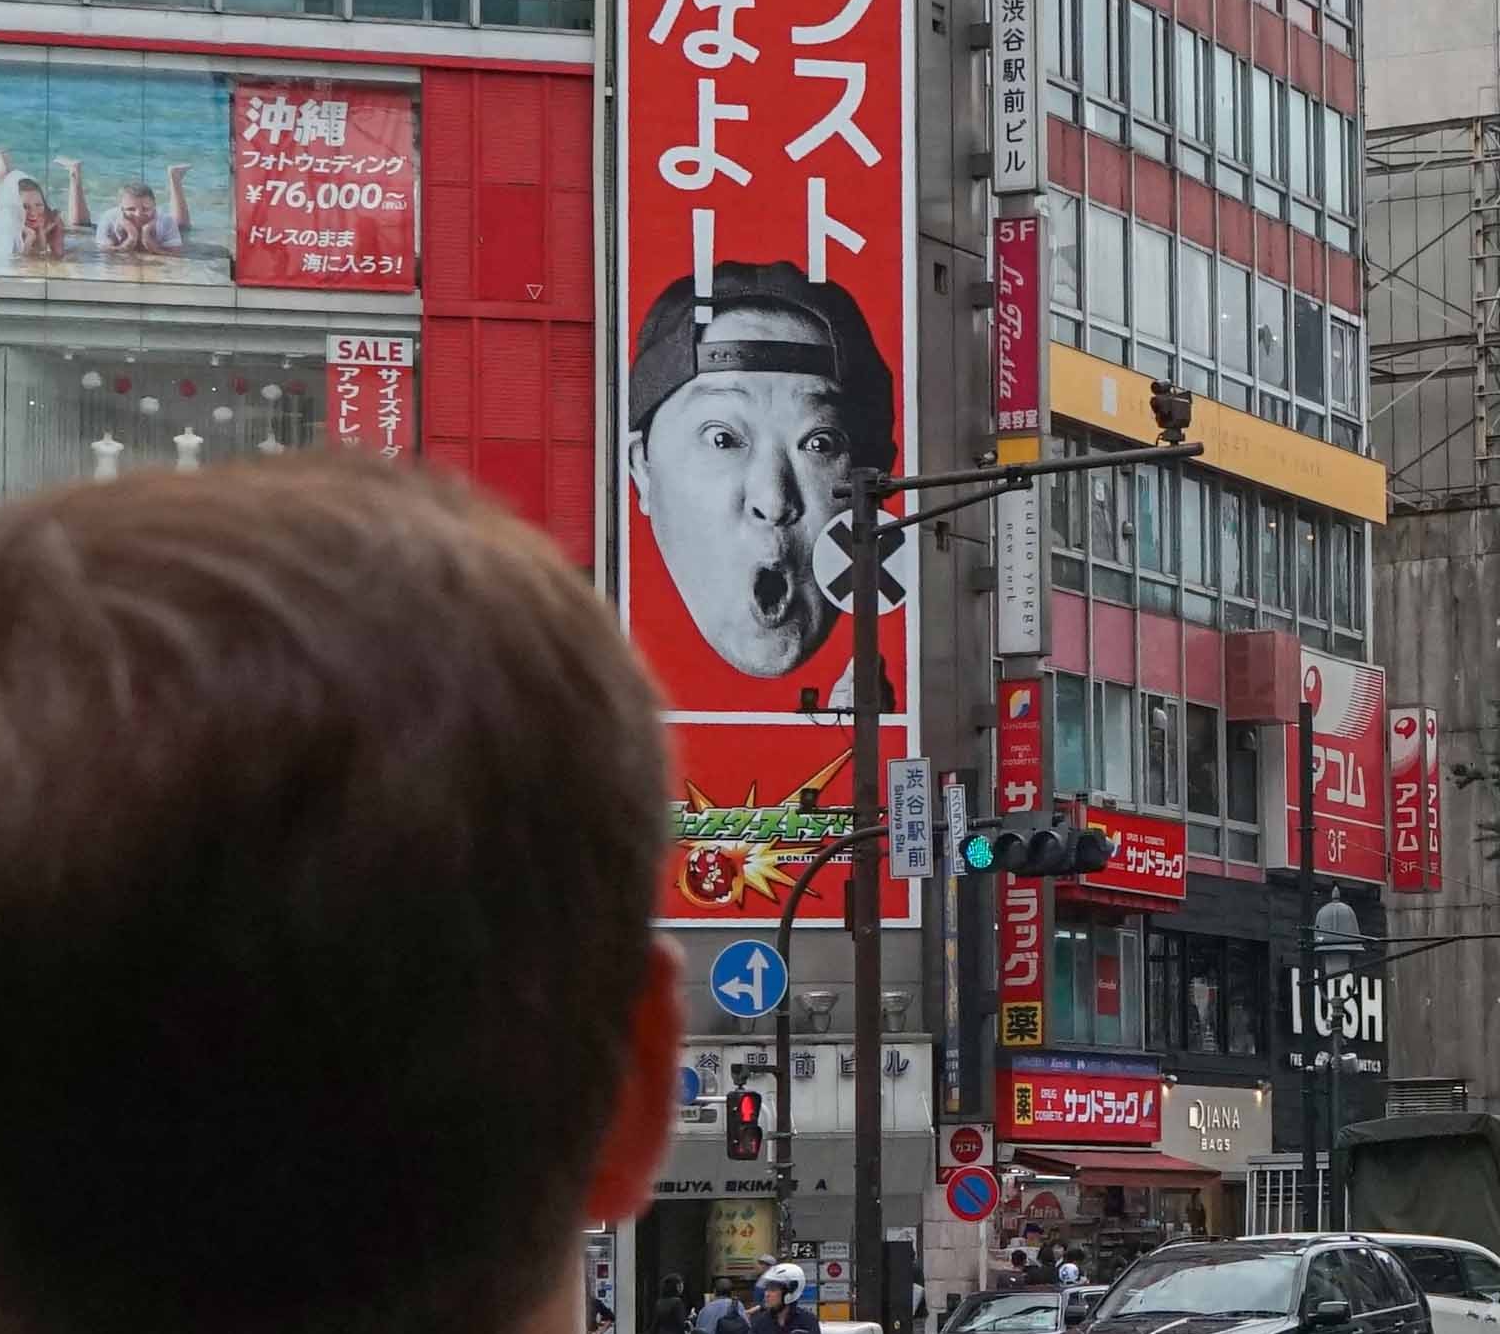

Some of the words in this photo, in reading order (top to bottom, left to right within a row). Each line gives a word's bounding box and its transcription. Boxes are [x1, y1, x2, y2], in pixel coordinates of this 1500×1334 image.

[243, 96, 349, 147] 沖縄
[242, 151, 407, 175] フォトウェディング
[249, 227, 356, 248] ドレスのまま
[999, 219, 1037, 243] 5F
[302, 253, 404, 275] 海に入ろう!
[337, 341, 404, 363] SALE
[906, 768, 927, 868] 渋谷駅前
[1394, 782, 1420, 854] アコム
[1126, 845, 1184, 880] サンドラッグ
[1326, 827, 1349, 865] 3F
[1005, 1006, 1040, 1045] 薬
[1015, 1086, 1033, 1122] 薬
[1063, 1088, 1139, 1124] サンドラッグ
[1189, 1098, 1242, 1135] DIANA
[954, 1142, 981, 1155] ガスト
[1200, 1137, 1232, 1151] BAGS
